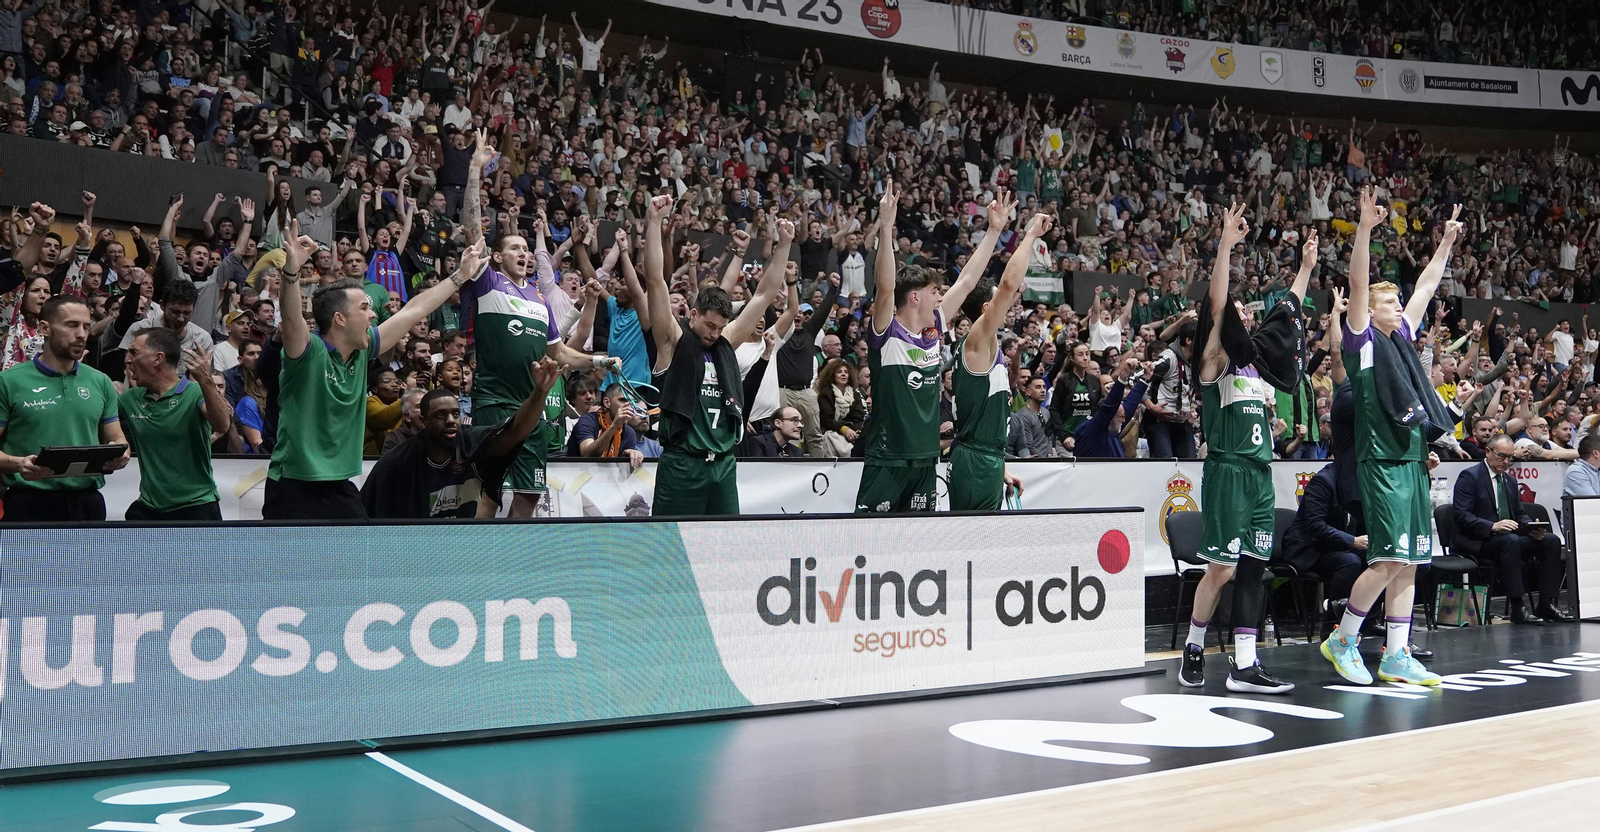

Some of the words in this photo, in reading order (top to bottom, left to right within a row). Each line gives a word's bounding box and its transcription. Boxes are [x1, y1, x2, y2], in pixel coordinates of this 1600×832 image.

[798, 0, 843, 25] 23
[868, 10, 888, 19] Copa
[878, 19, 891, 29] Rey
[1160, 38, 1190, 47] CAZOO
[1061, 53, 1091, 65] BARÇA
[1429, 79, 1469, 89] Ajuntament
[1481, 82, 1511, 91] Badalona
[708, 408, 721, 430] 7
[1251, 423, 1264, 446] 8
[756, 555, 947, 626] divina
[995, 566, 1106, 626] acb
[853, 626, 947, 658] seguros
